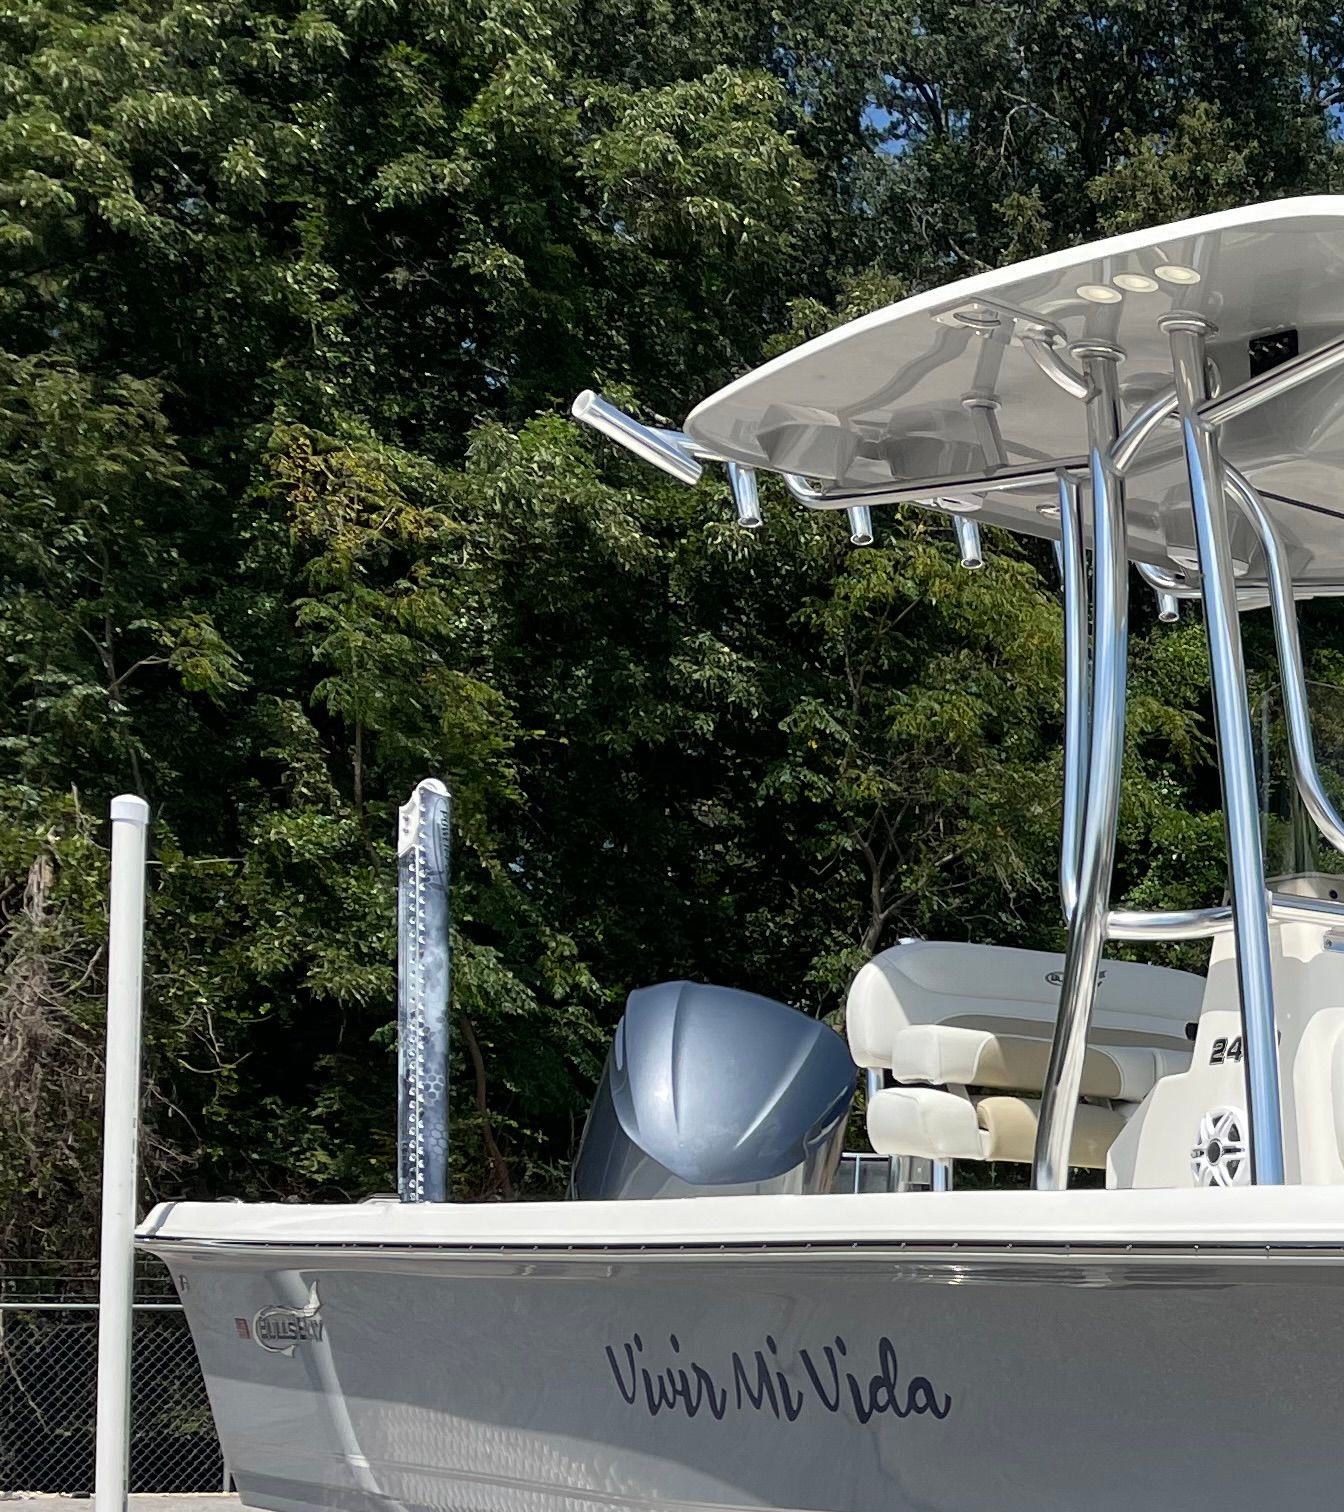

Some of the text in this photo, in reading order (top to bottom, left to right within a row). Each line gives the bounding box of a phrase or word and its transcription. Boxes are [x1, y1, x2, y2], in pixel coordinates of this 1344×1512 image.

[605, 1333, 952, 1425] Vivir Mi Vida
